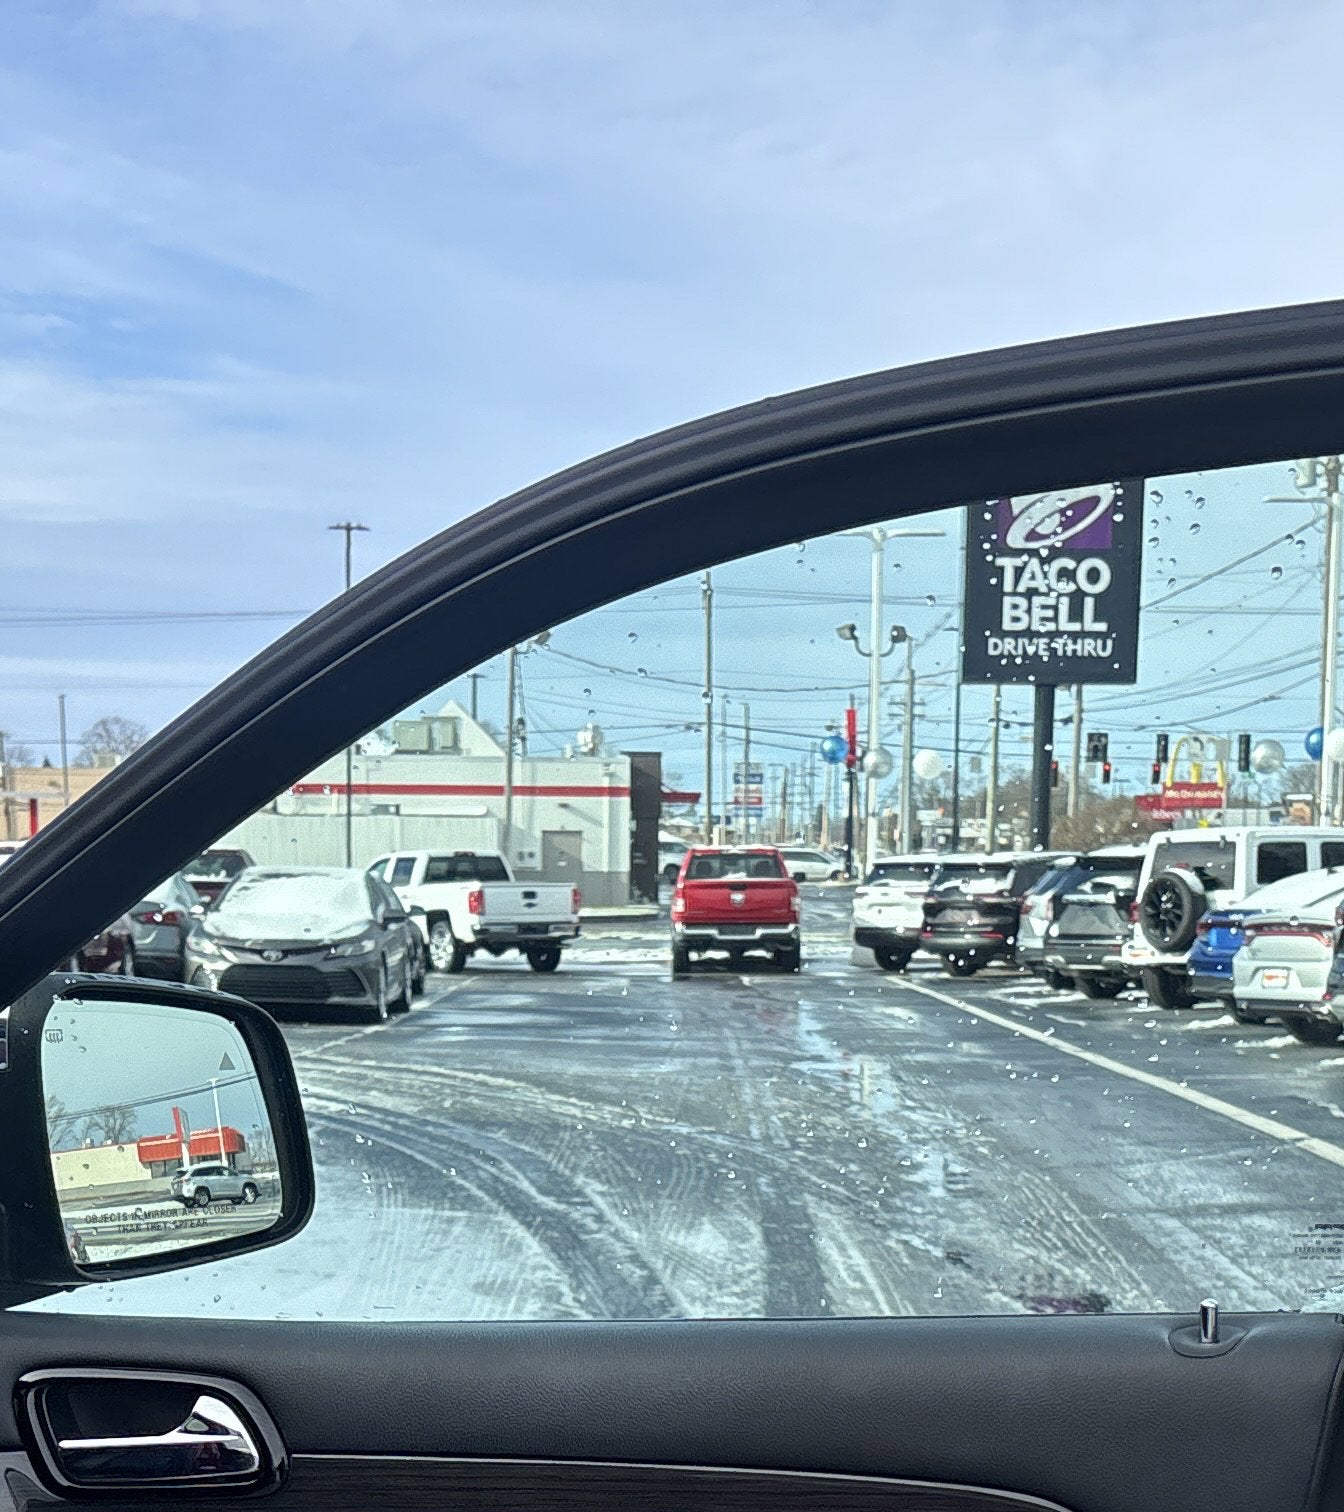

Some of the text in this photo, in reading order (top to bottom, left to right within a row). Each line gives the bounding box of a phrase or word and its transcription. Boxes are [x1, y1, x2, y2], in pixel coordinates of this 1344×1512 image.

[995, 557, 1112, 594] TACO
[1002, 596, 1108, 632] BELL
[85, 1212, 128, 1224] OBJECTS
